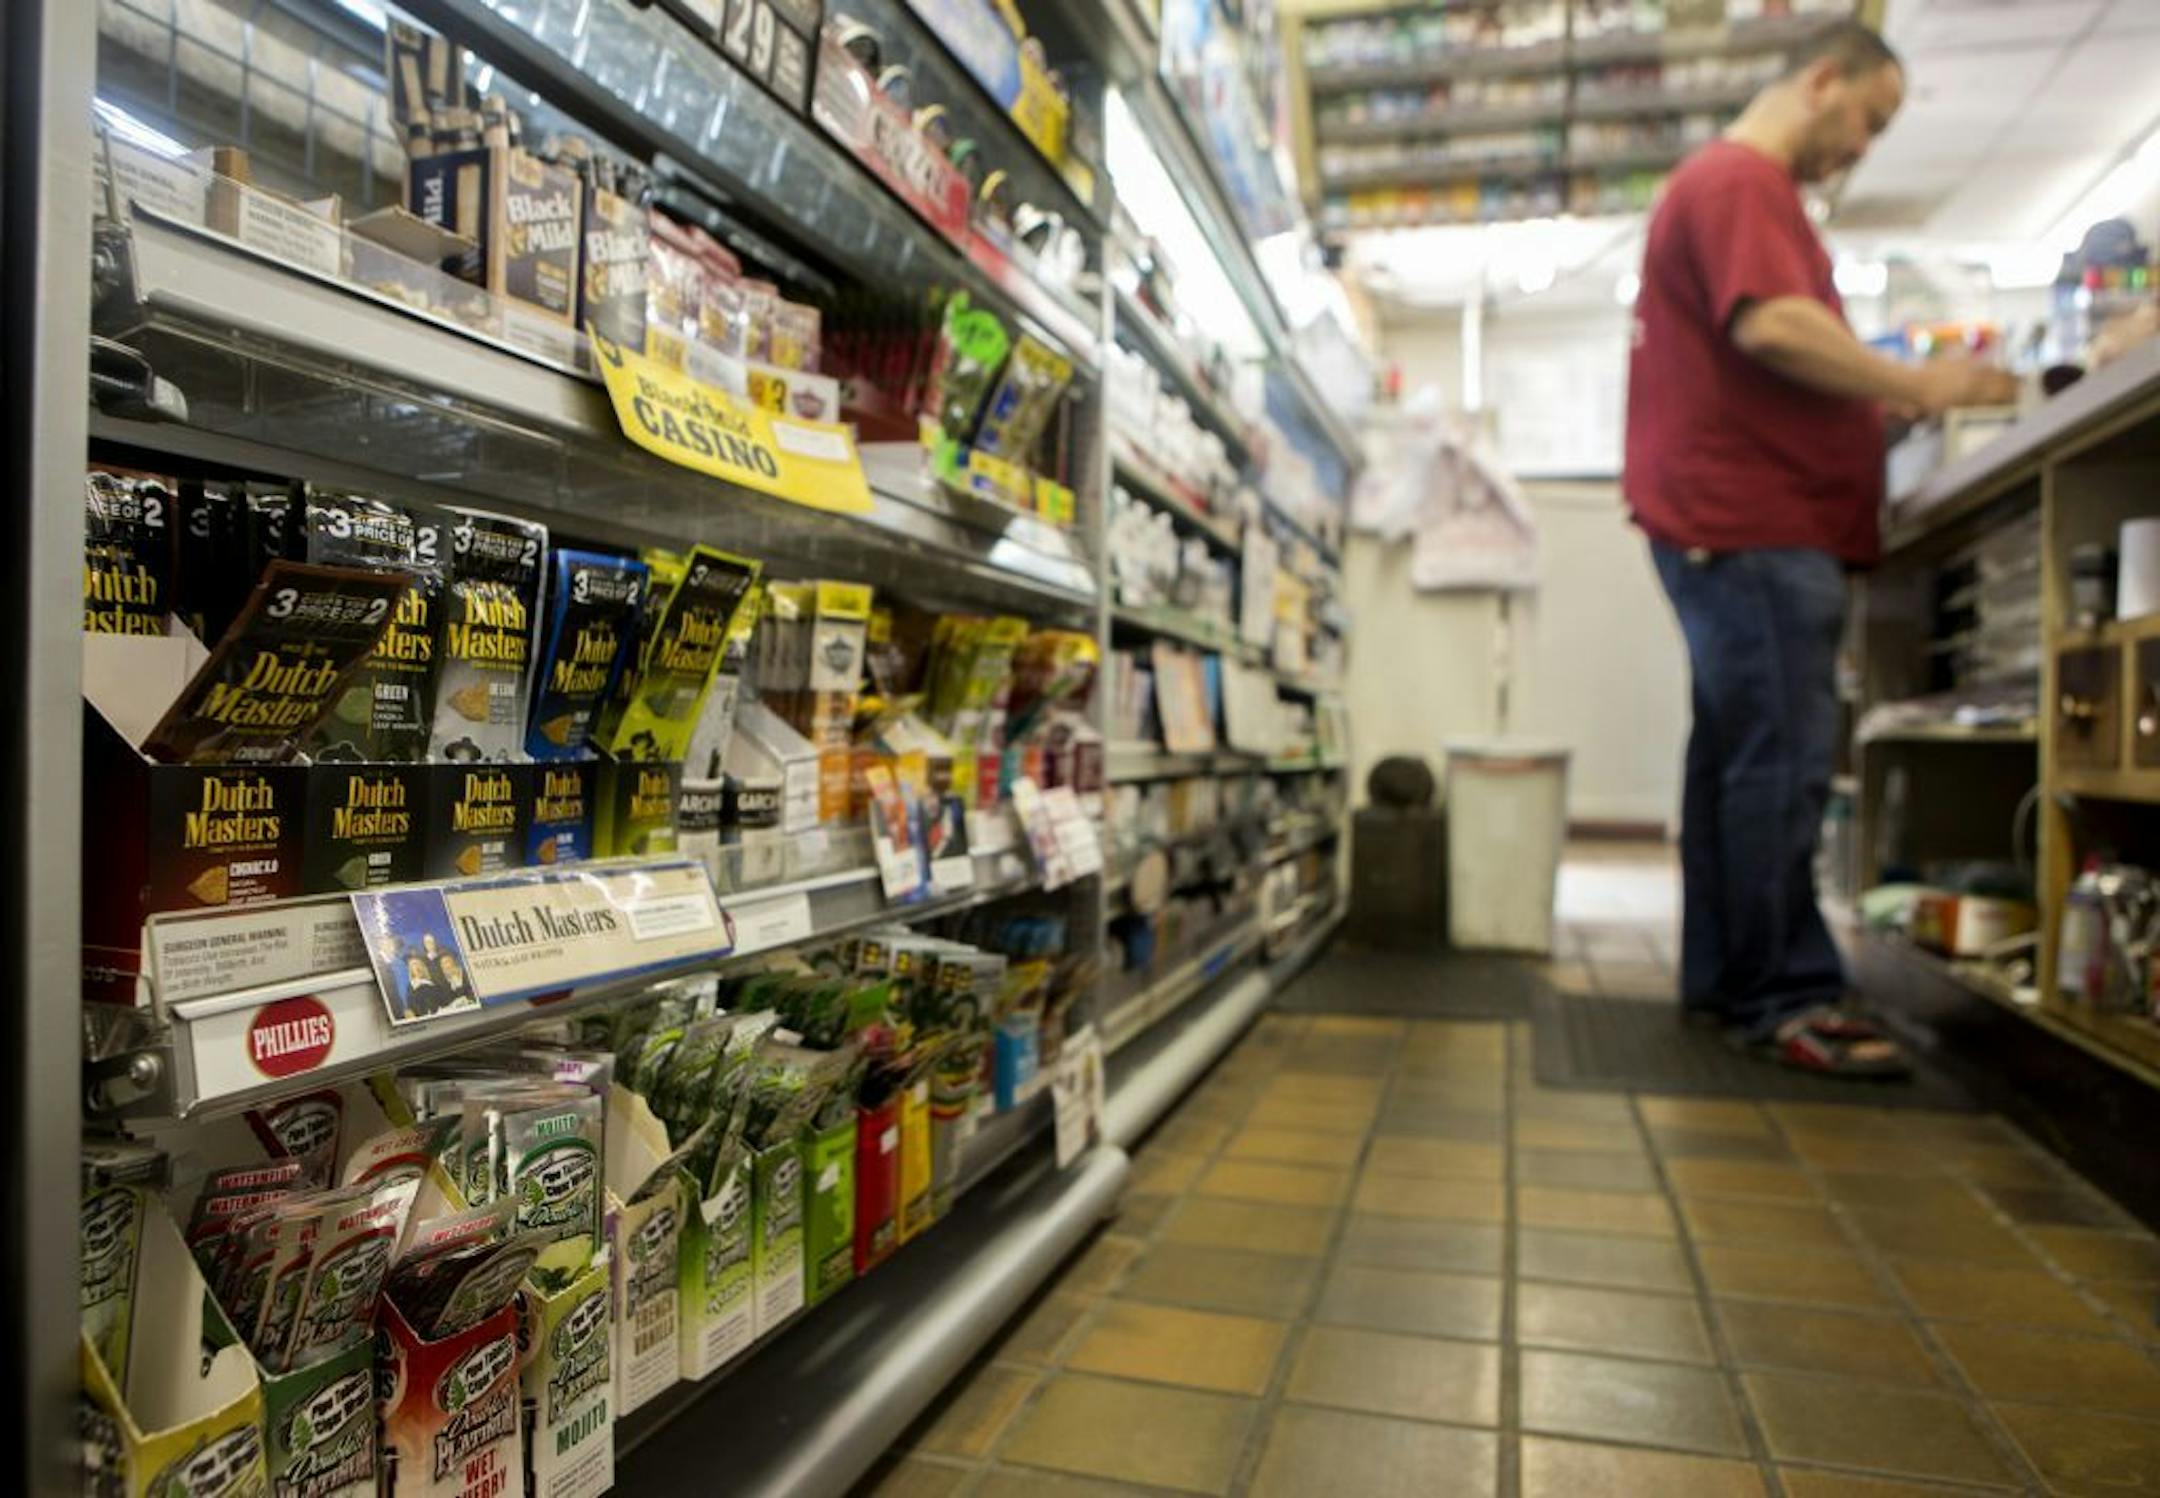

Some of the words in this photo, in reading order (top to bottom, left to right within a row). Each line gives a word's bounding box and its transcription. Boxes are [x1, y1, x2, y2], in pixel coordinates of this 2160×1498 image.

[423, 177, 444, 223] ild
[507, 192, 574, 223] Black
[526, 220, 574, 253] Mild
[586, 222, 650, 263] Black
[633, 396, 778, 478] CASINO
[143, 497, 165, 528] 2
[328, 508, 351, 538] 3
[355, 524, 397, 543] PRICE
[417, 526, 438, 555] 2
[454, 526, 473, 553] 3
[520, 539, 538, 567] 2
[573, 568, 590, 601] 3
[626, 580, 641, 605] 2
[268, 588, 299, 618] 3
[297, 605, 341, 619] PRICE
[361, 598, 388, 624] 2
[84, 604, 163, 636] asters
[372, 623, 432, 661] sters
[446, 624, 527, 661] Masters
[244, 651, 338, 696] Dutch
[201, 777, 273, 811] Dutch
[349, 775, 406, 808] Dutch
[465, 773, 512, 802] Dutch
[545, 770, 582, 797] Dutch
[332, 807, 410, 839] Masters
[453, 800, 515, 831] Masters
[535, 796, 583, 823] Masters
[184, 810, 280, 849] Masters
[164, 937, 208, 953] SURGEON
[210, 931, 247, 948] GENERAL
[249, 926, 288, 942] WARNING
[460, 910, 536, 952] Dutch
[533, 905, 617, 941] Masters
[252, 1013, 331, 1060] PHILLIES
[535, 1112, 577, 1137] MOJITO
[465, 1361, 484, 1380] Pipe
[468, 1372, 491, 1395] Cigar
[314, 1409, 343, 1436] Cigar
[556, 1398, 607, 1457] MOJITO
[456, 1464, 506, 1498] ERRY
[465, 1448, 495, 1485] WET
